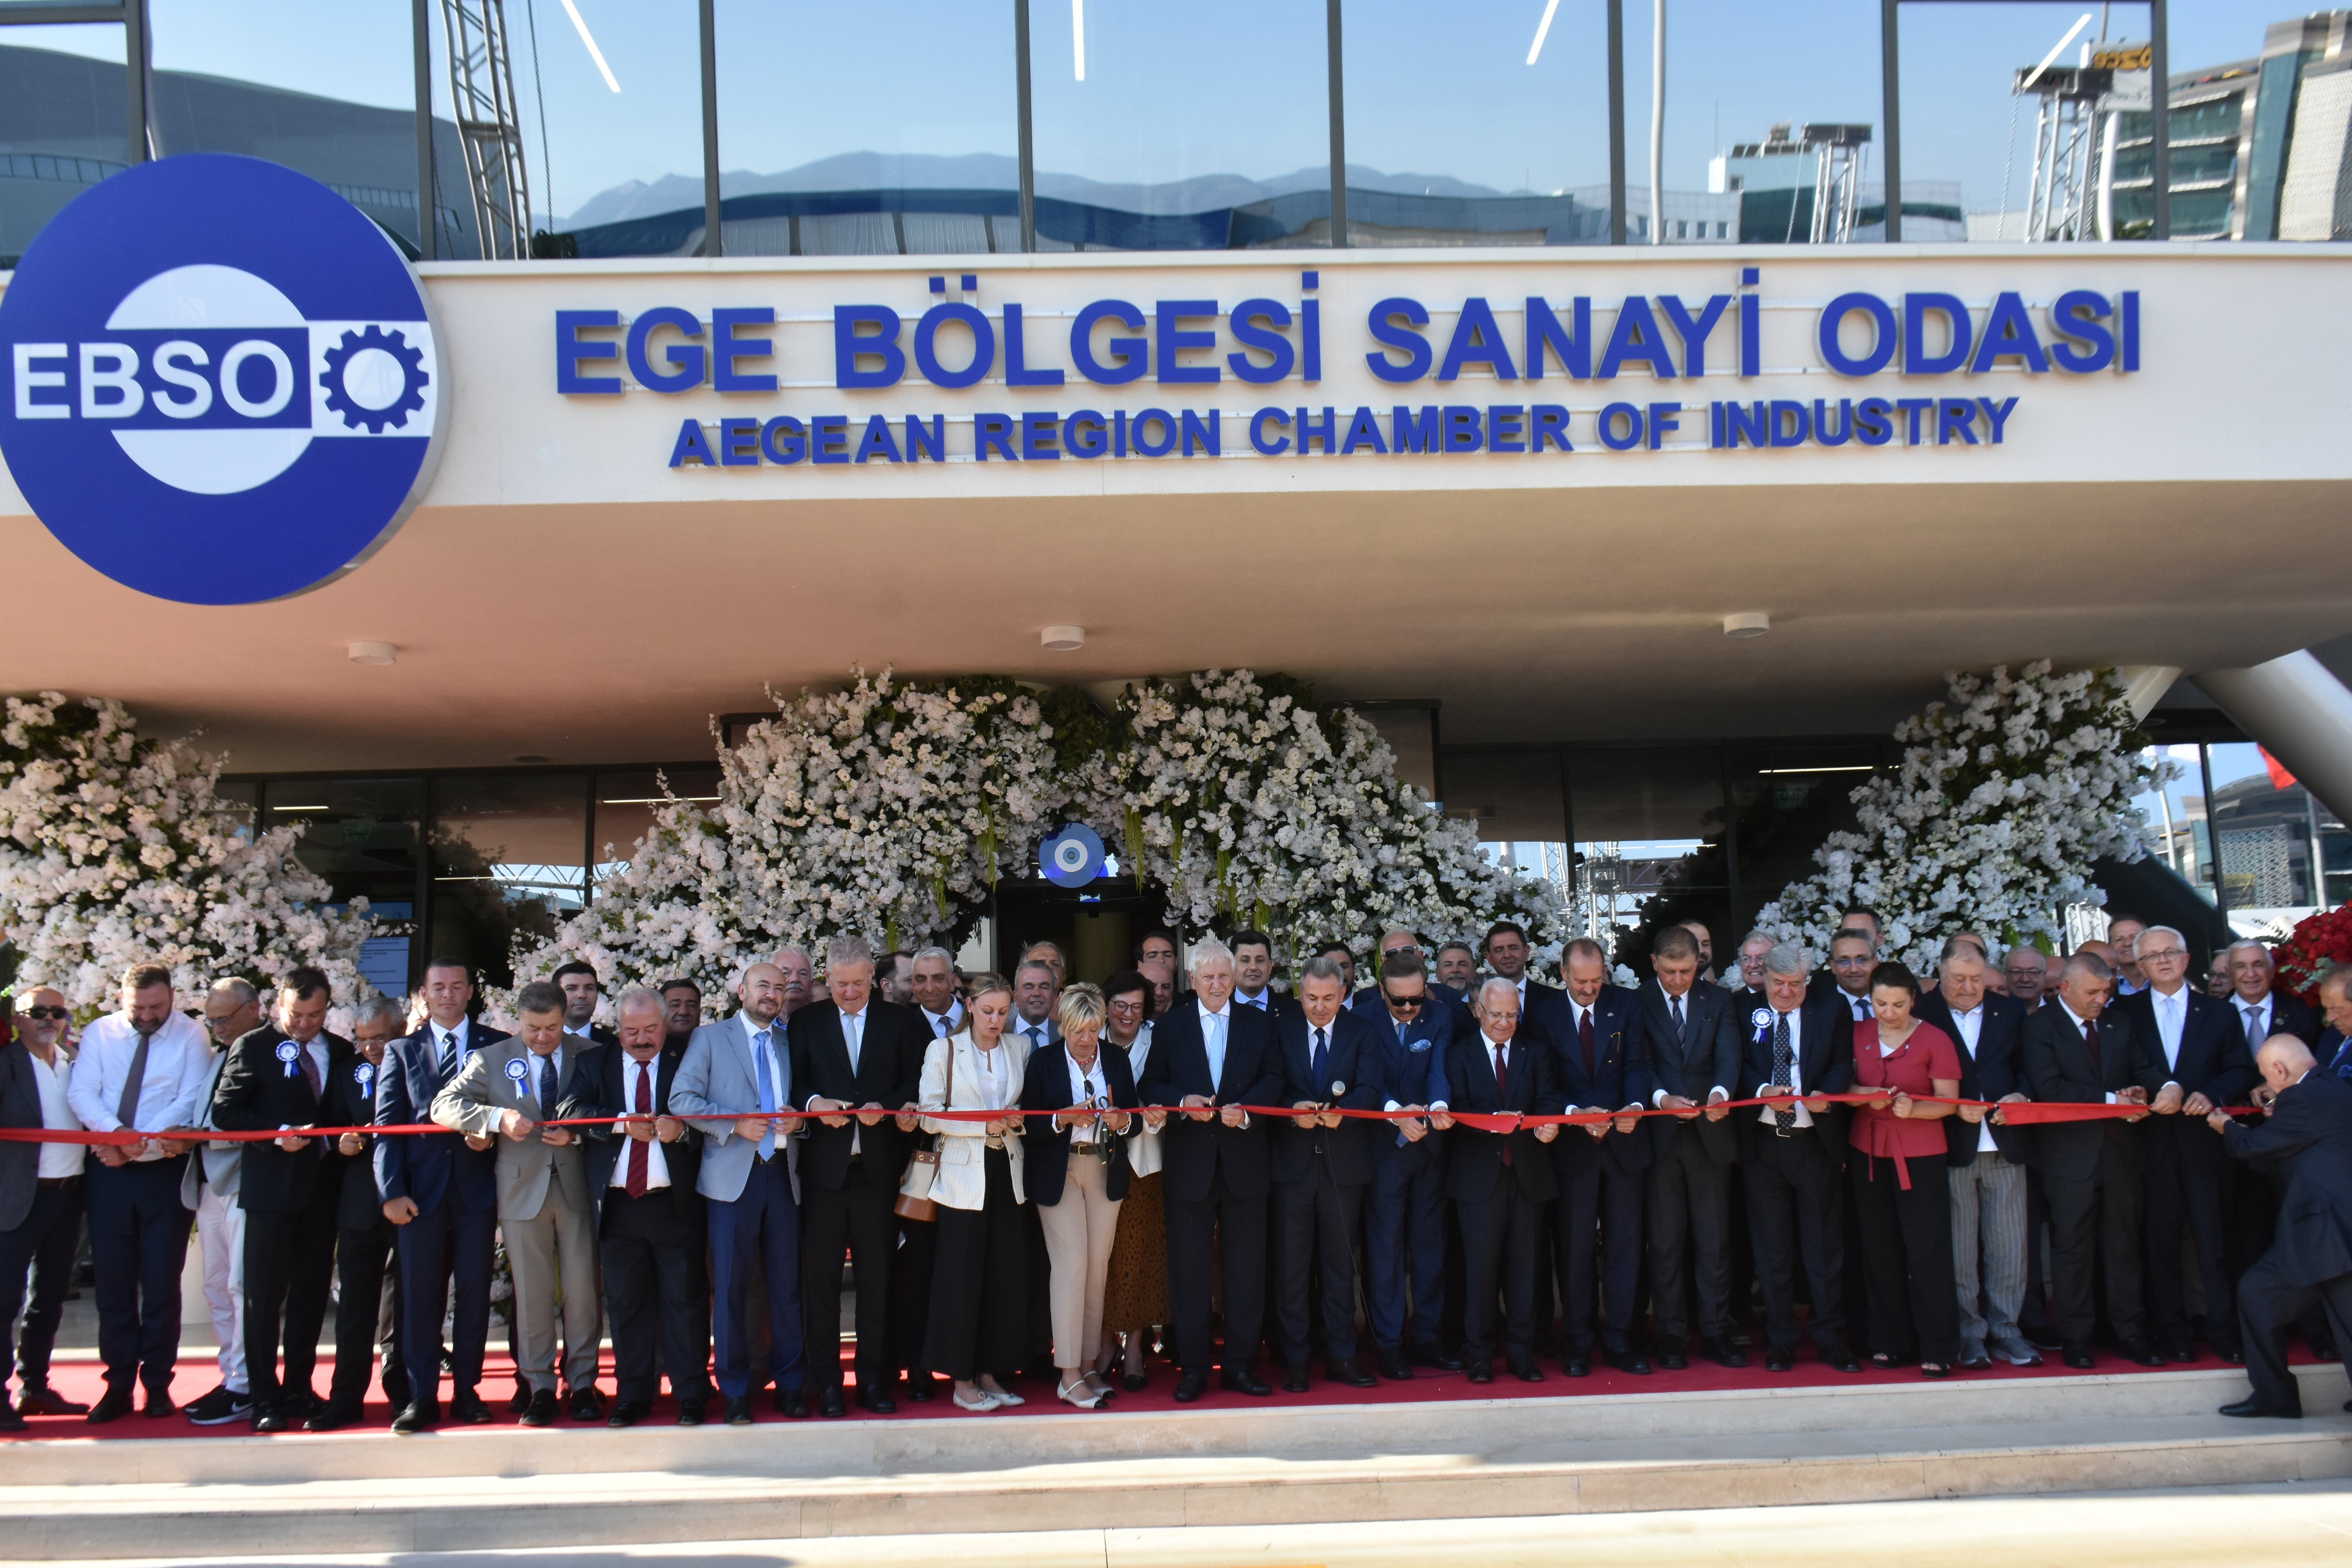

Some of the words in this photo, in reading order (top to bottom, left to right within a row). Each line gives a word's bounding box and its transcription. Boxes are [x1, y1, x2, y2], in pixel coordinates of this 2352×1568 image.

[555, 306, 779, 394] EGE
[833, 271, 1322, 389] BÖLGESİ
[1366, 268, 1761, 383] SANAYİ
[1819, 289, 2141, 376] ODASI
[13, 339, 294, 420] EBSO
[669, 414, 946, 467] AEGEAN
[974, 408, 1221, 461] REGION
[1250, 404, 1575, 455] CHAMBER
[1599, 402, 1683, 450] OF
[1711, 397, 2019, 448] INDUSTRY
